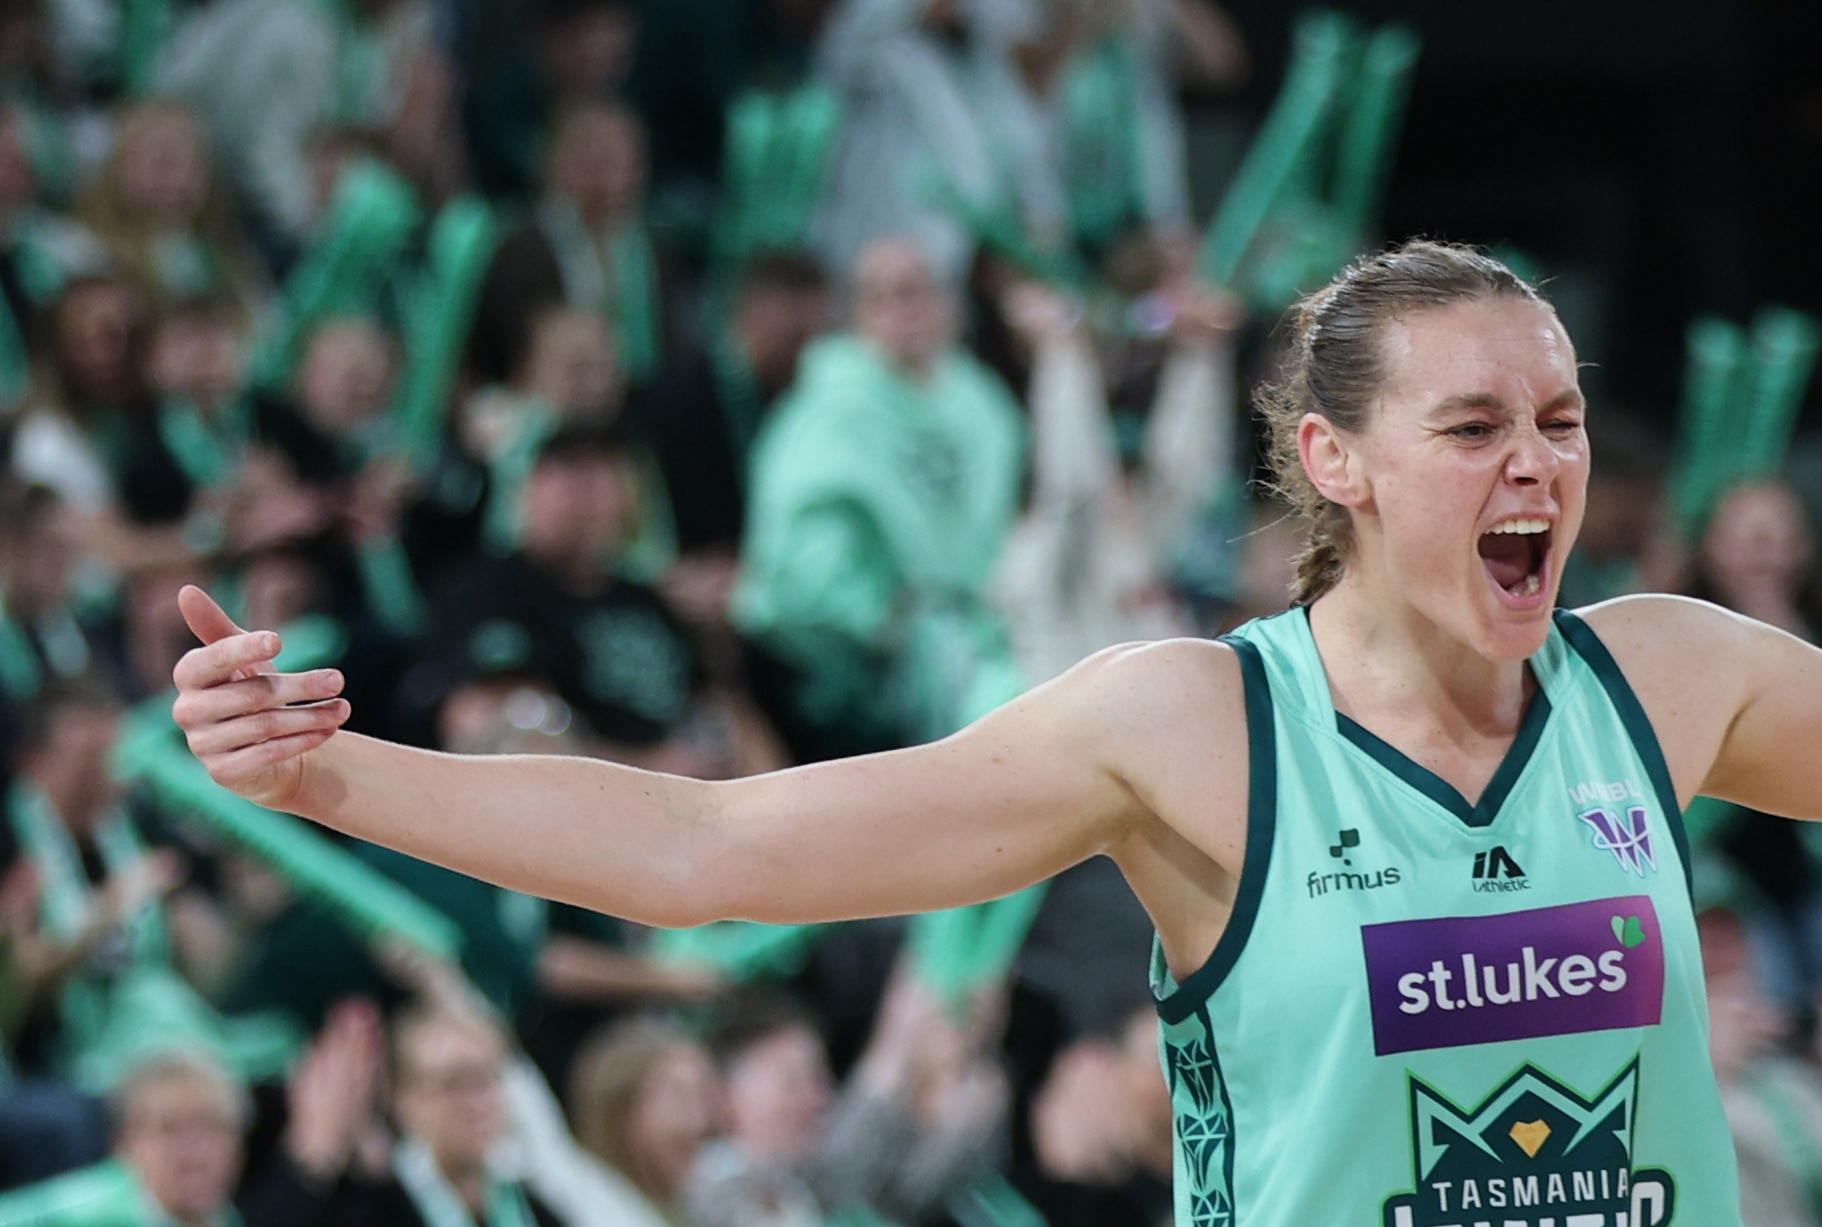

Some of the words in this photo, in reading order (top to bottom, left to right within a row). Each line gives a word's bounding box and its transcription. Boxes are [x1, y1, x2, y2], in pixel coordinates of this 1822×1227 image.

[1307, 867, 1401, 898] firmus
[1398, 946, 1627, 1014] st.lukes
[1432, 1168, 1628, 1211] TASMANIA
